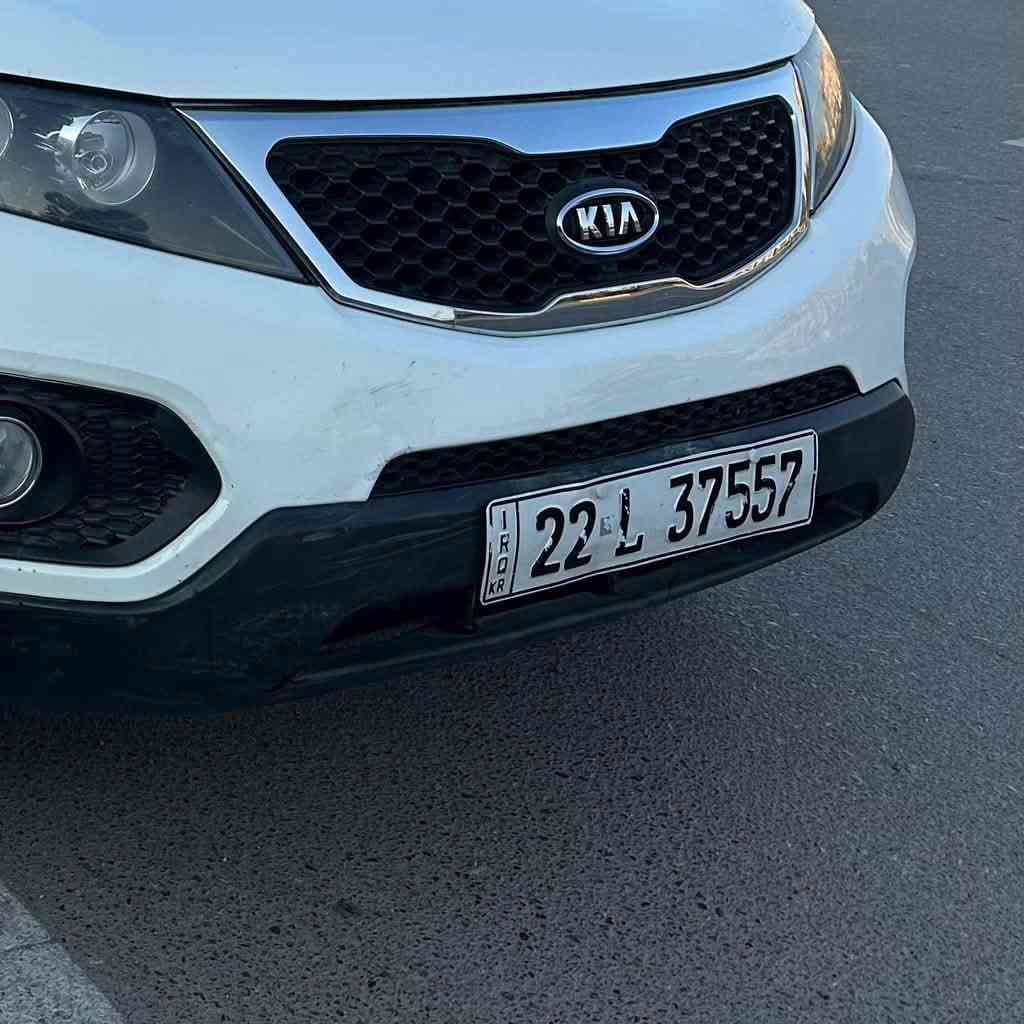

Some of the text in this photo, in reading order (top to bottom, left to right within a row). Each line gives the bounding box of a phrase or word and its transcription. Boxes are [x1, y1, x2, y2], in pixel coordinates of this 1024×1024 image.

[575, 201, 642, 241] KIA
[530, 449, 804, 578] 22 L 37557
[488, 578, 505, 595] KR
